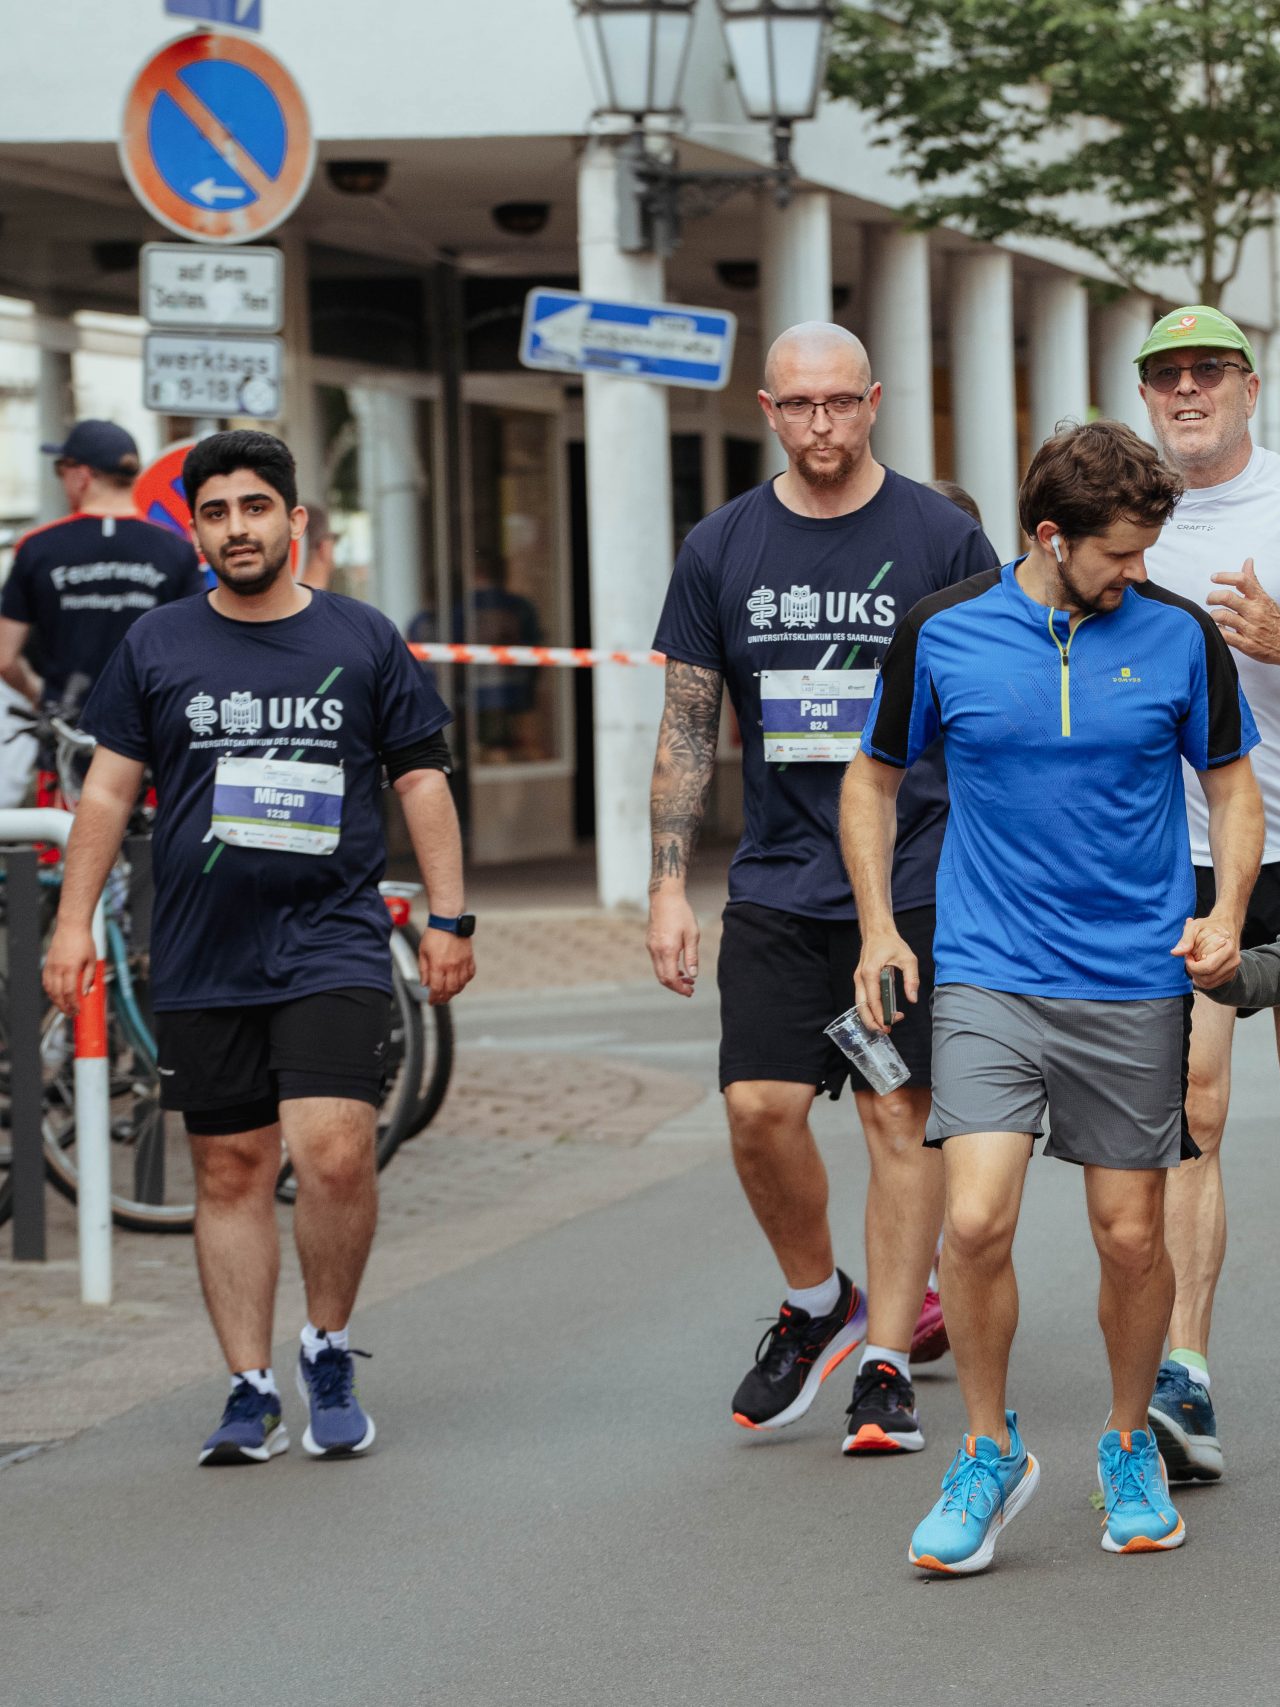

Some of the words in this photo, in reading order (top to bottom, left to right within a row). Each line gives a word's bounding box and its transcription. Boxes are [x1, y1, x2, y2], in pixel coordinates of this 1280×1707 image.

[178, 263, 204, 281] auf
[156, 348, 268, 375] werktags
[50, 561, 167, 591] Feuerwehr
[826, 591, 896, 627] UKS
[747, 632, 831, 644] UNIVERSITÄTSKLINIKUM
[833, 632, 846, 641] DES
[269, 697, 344, 731] UKS
[800, 699, 838, 717] Paul
[809, 720, 828, 731] 824
[274, 737, 290, 746] DES
[290, 737, 338, 749] SAARLANDES
[253, 787, 305, 808] Miran
